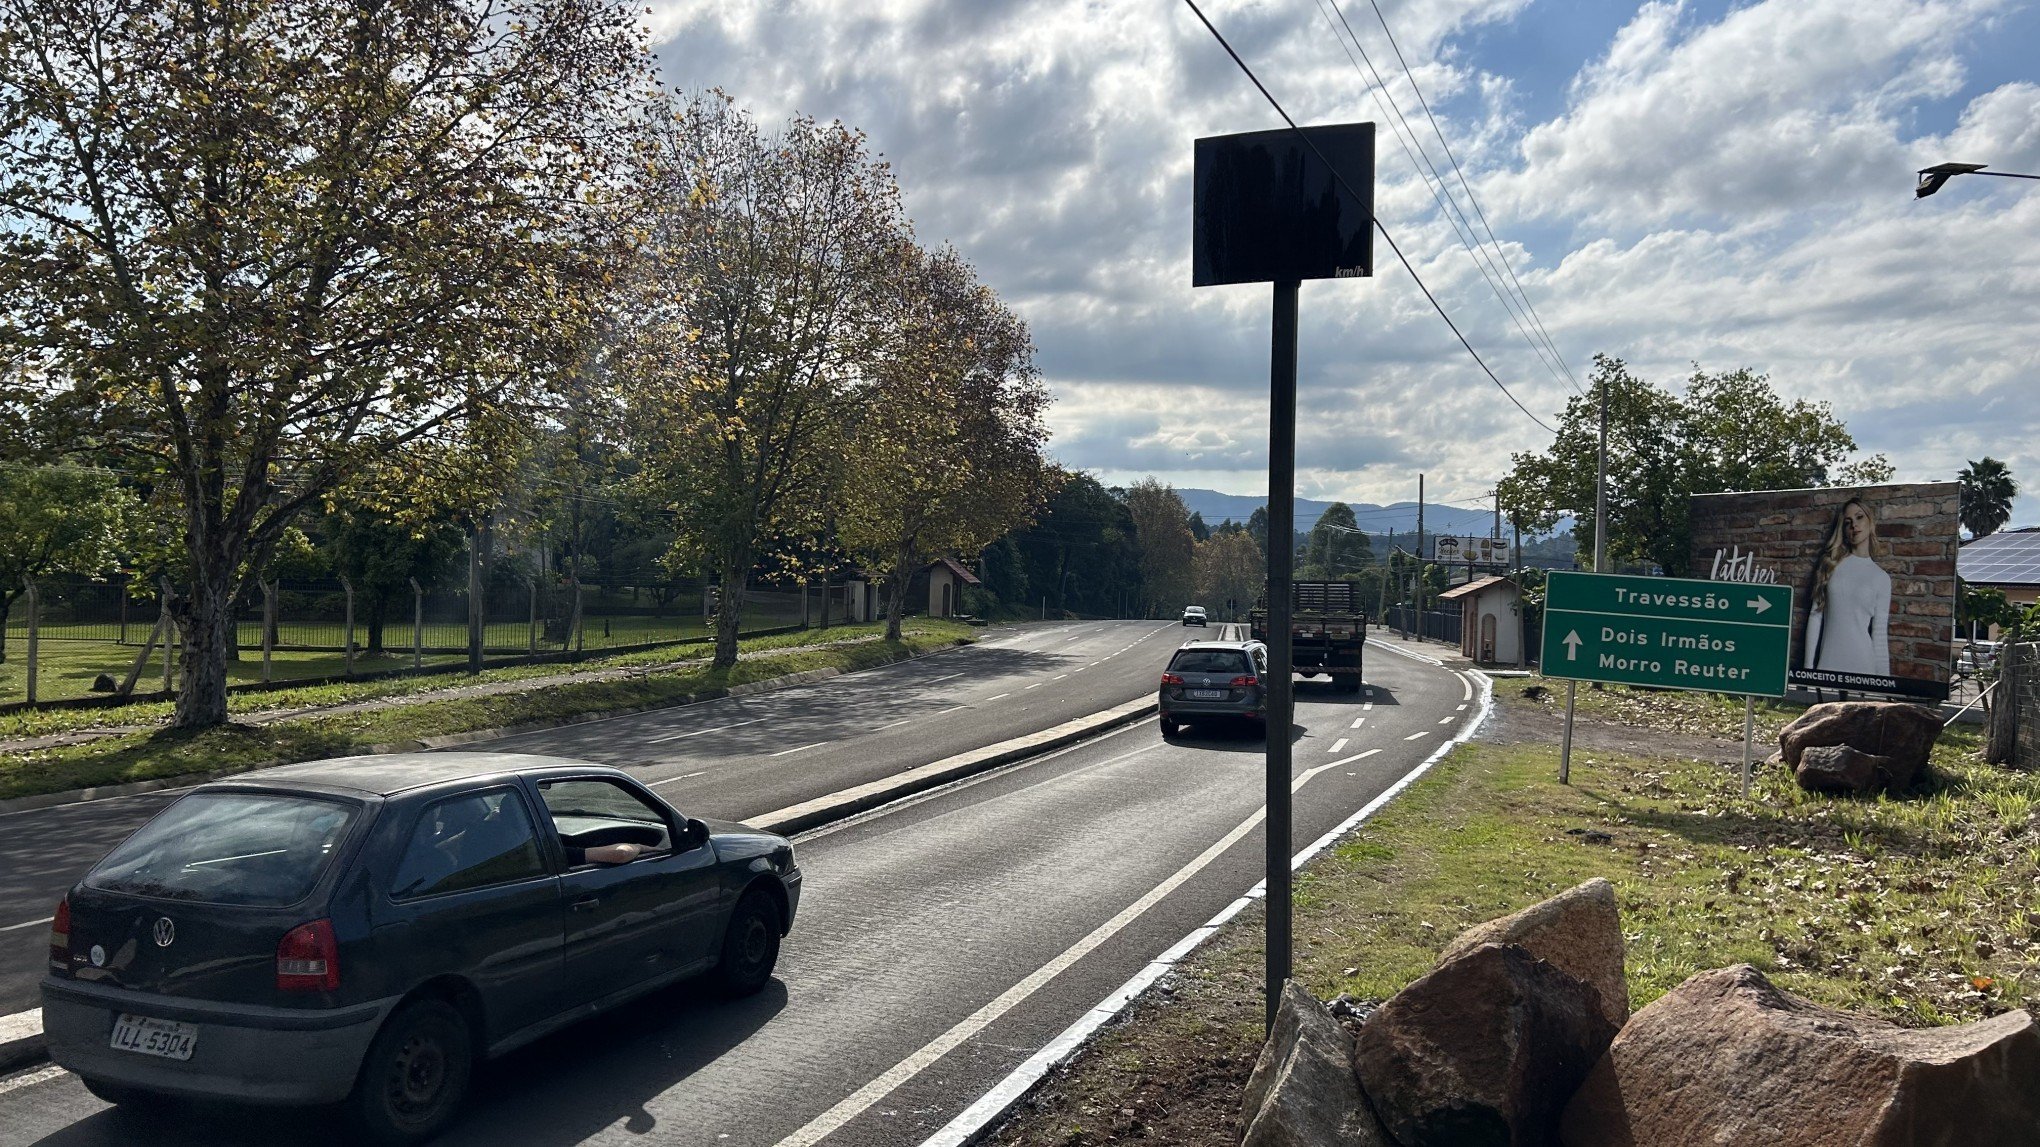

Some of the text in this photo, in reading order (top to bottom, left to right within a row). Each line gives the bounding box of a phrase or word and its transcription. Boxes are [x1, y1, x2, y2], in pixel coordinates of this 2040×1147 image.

[1335, 265, 1364, 278] km/h
[1615, 587, 1730, 610] Travessão
[1601, 626, 1736, 652] Dois Irmãos
[1599, 653, 1750, 680] Morro Reuter
[1795, 670, 1836, 682] CONCEITO
[1837, 674, 1843, 683] E
[1844, 675, 1896, 688] SHOWROOM
